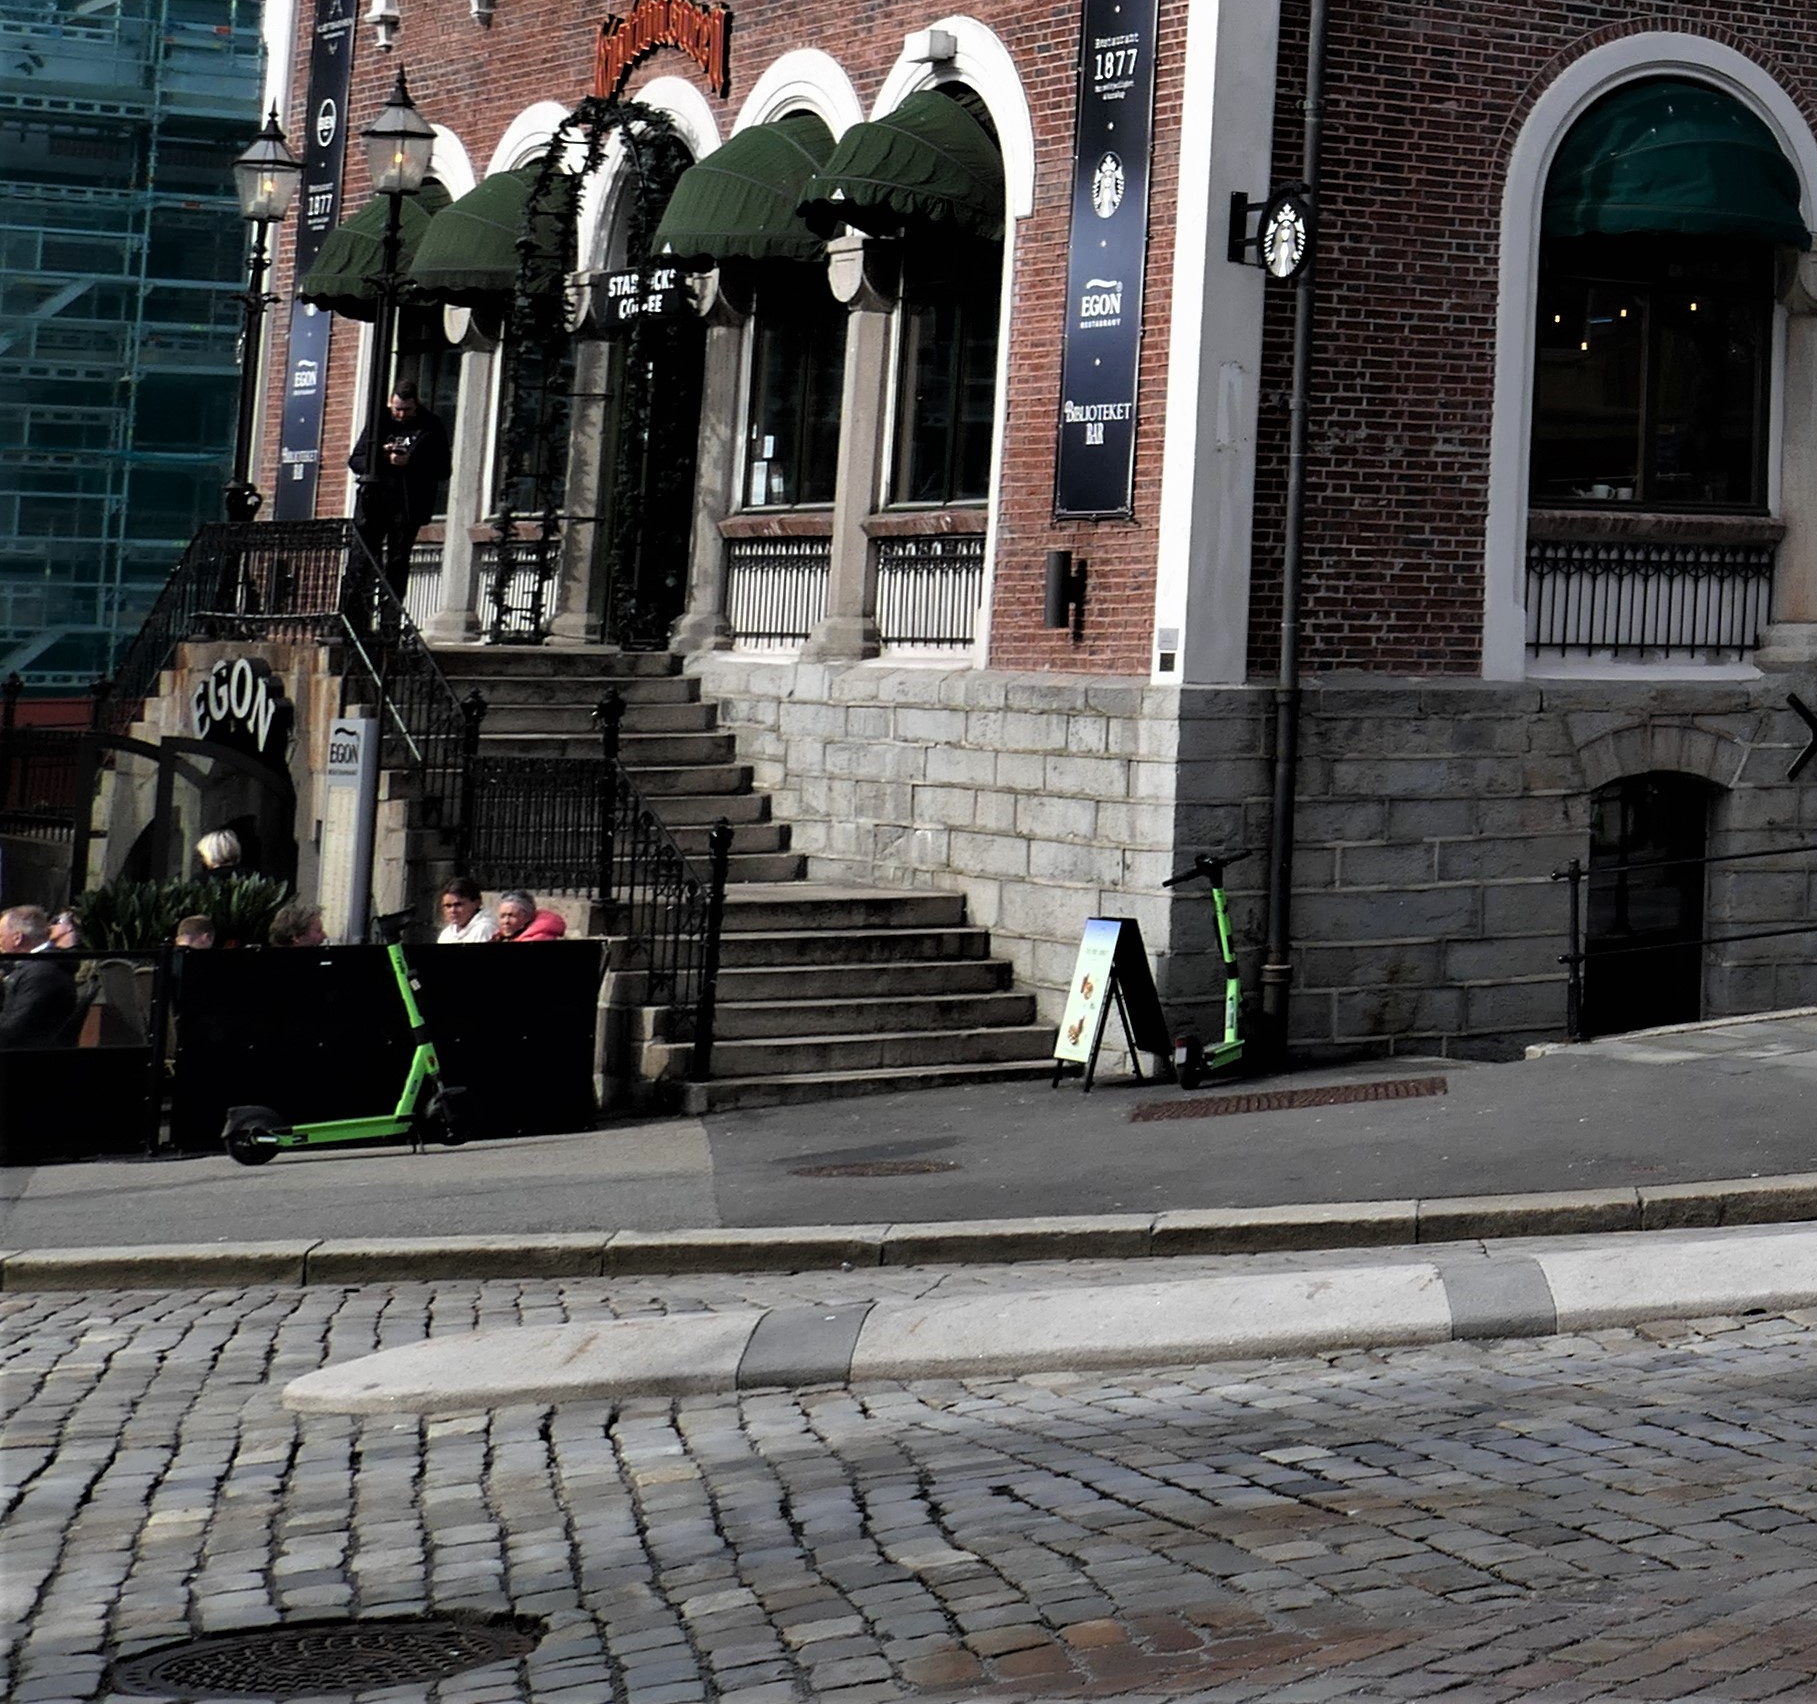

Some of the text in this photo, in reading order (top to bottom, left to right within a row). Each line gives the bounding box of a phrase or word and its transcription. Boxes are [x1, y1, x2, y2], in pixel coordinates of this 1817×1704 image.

[1094, 48, 1138, 80] 1877
[1081, 293, 1122, 317] EGON
[190, 658, 276, 753] EGON
[329, 743, 359, 765] EGON
